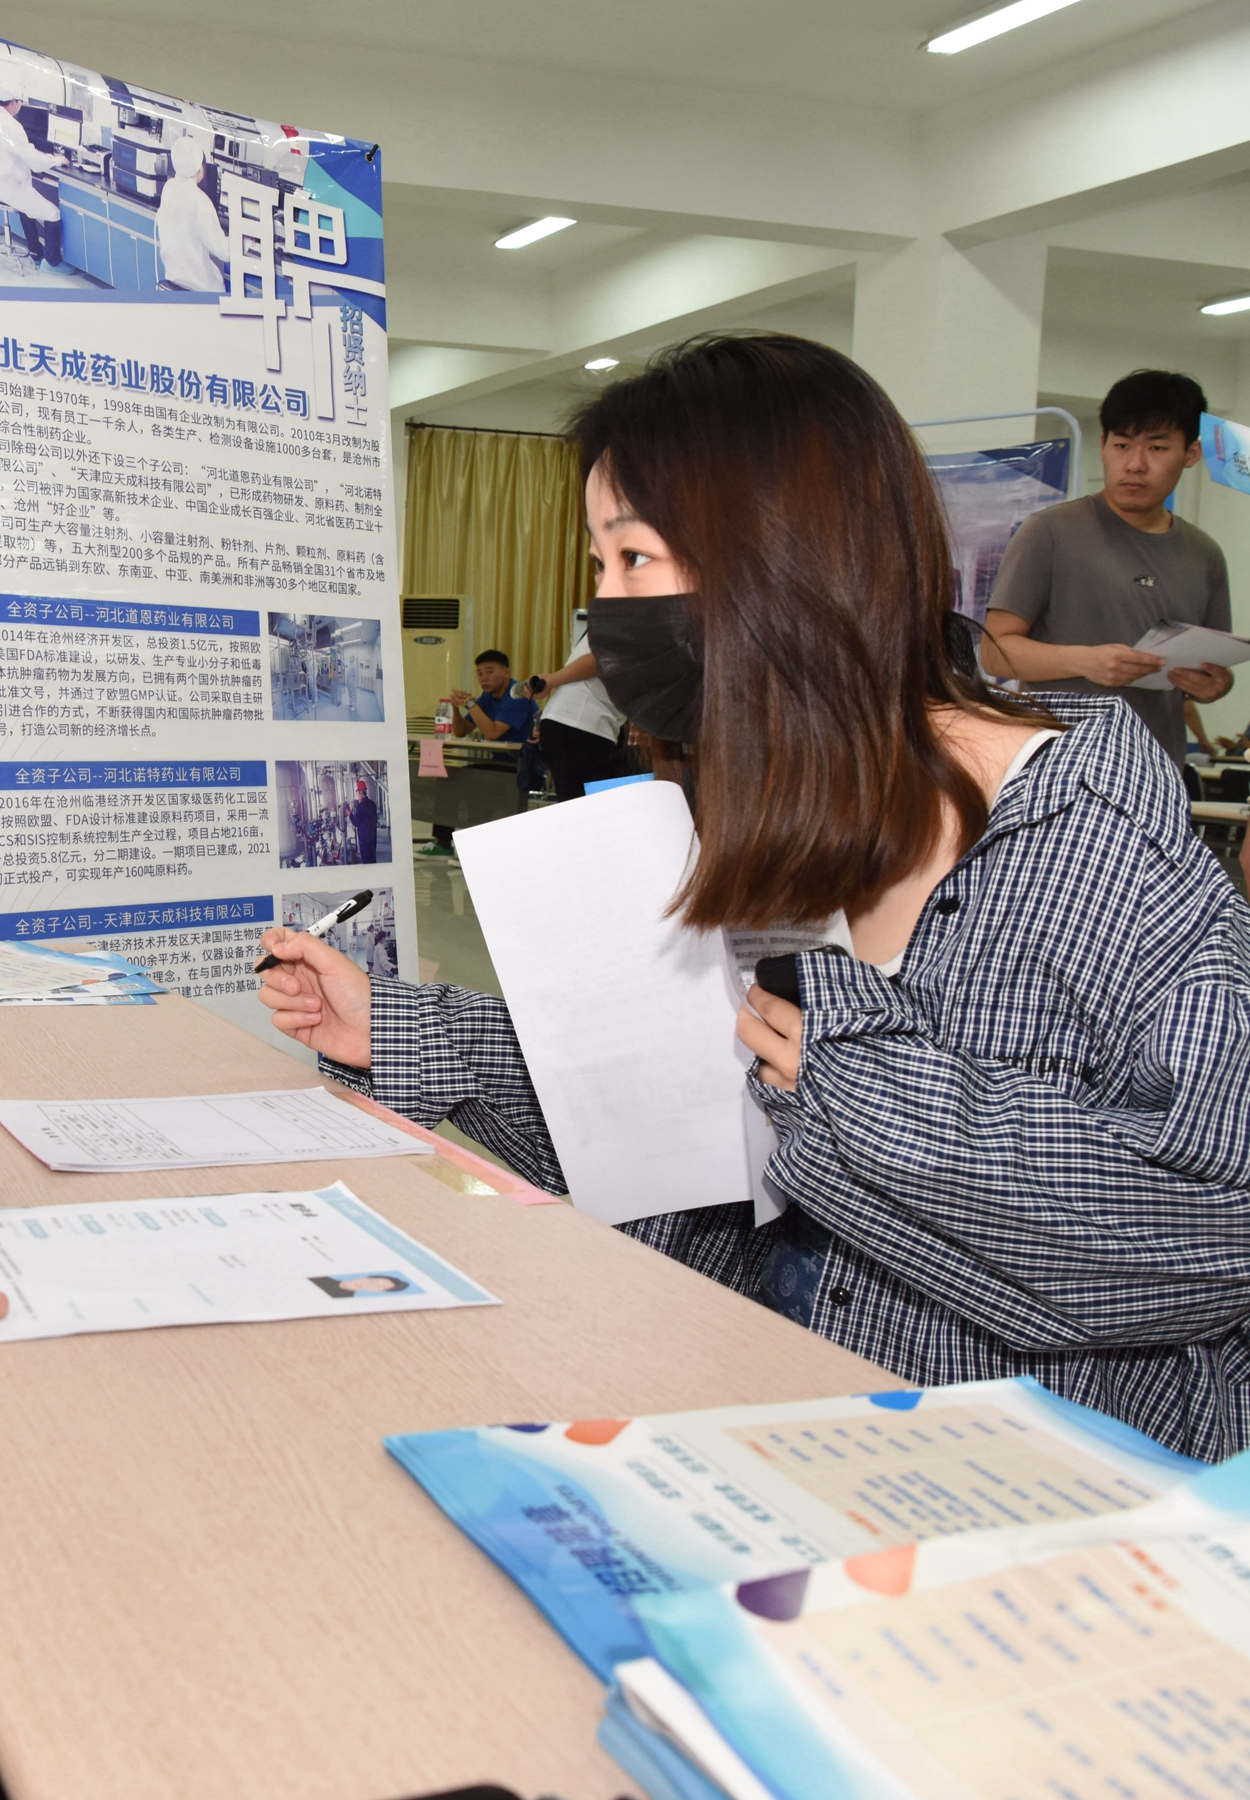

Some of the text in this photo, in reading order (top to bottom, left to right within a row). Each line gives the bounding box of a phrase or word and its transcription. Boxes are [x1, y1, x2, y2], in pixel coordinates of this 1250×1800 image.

[219, 171, 386, 419] 聘
[340, 303, 368, 427] 招贤纳士
[7, 601, 234, 630] 全资子公司--河北道恩药业有限公司
[15, 766, 241, 785] 全资子公司--河北诺特药业有限公司
[15, 903, 254, 936] 全资子公司--天津应天成科技有限公司
